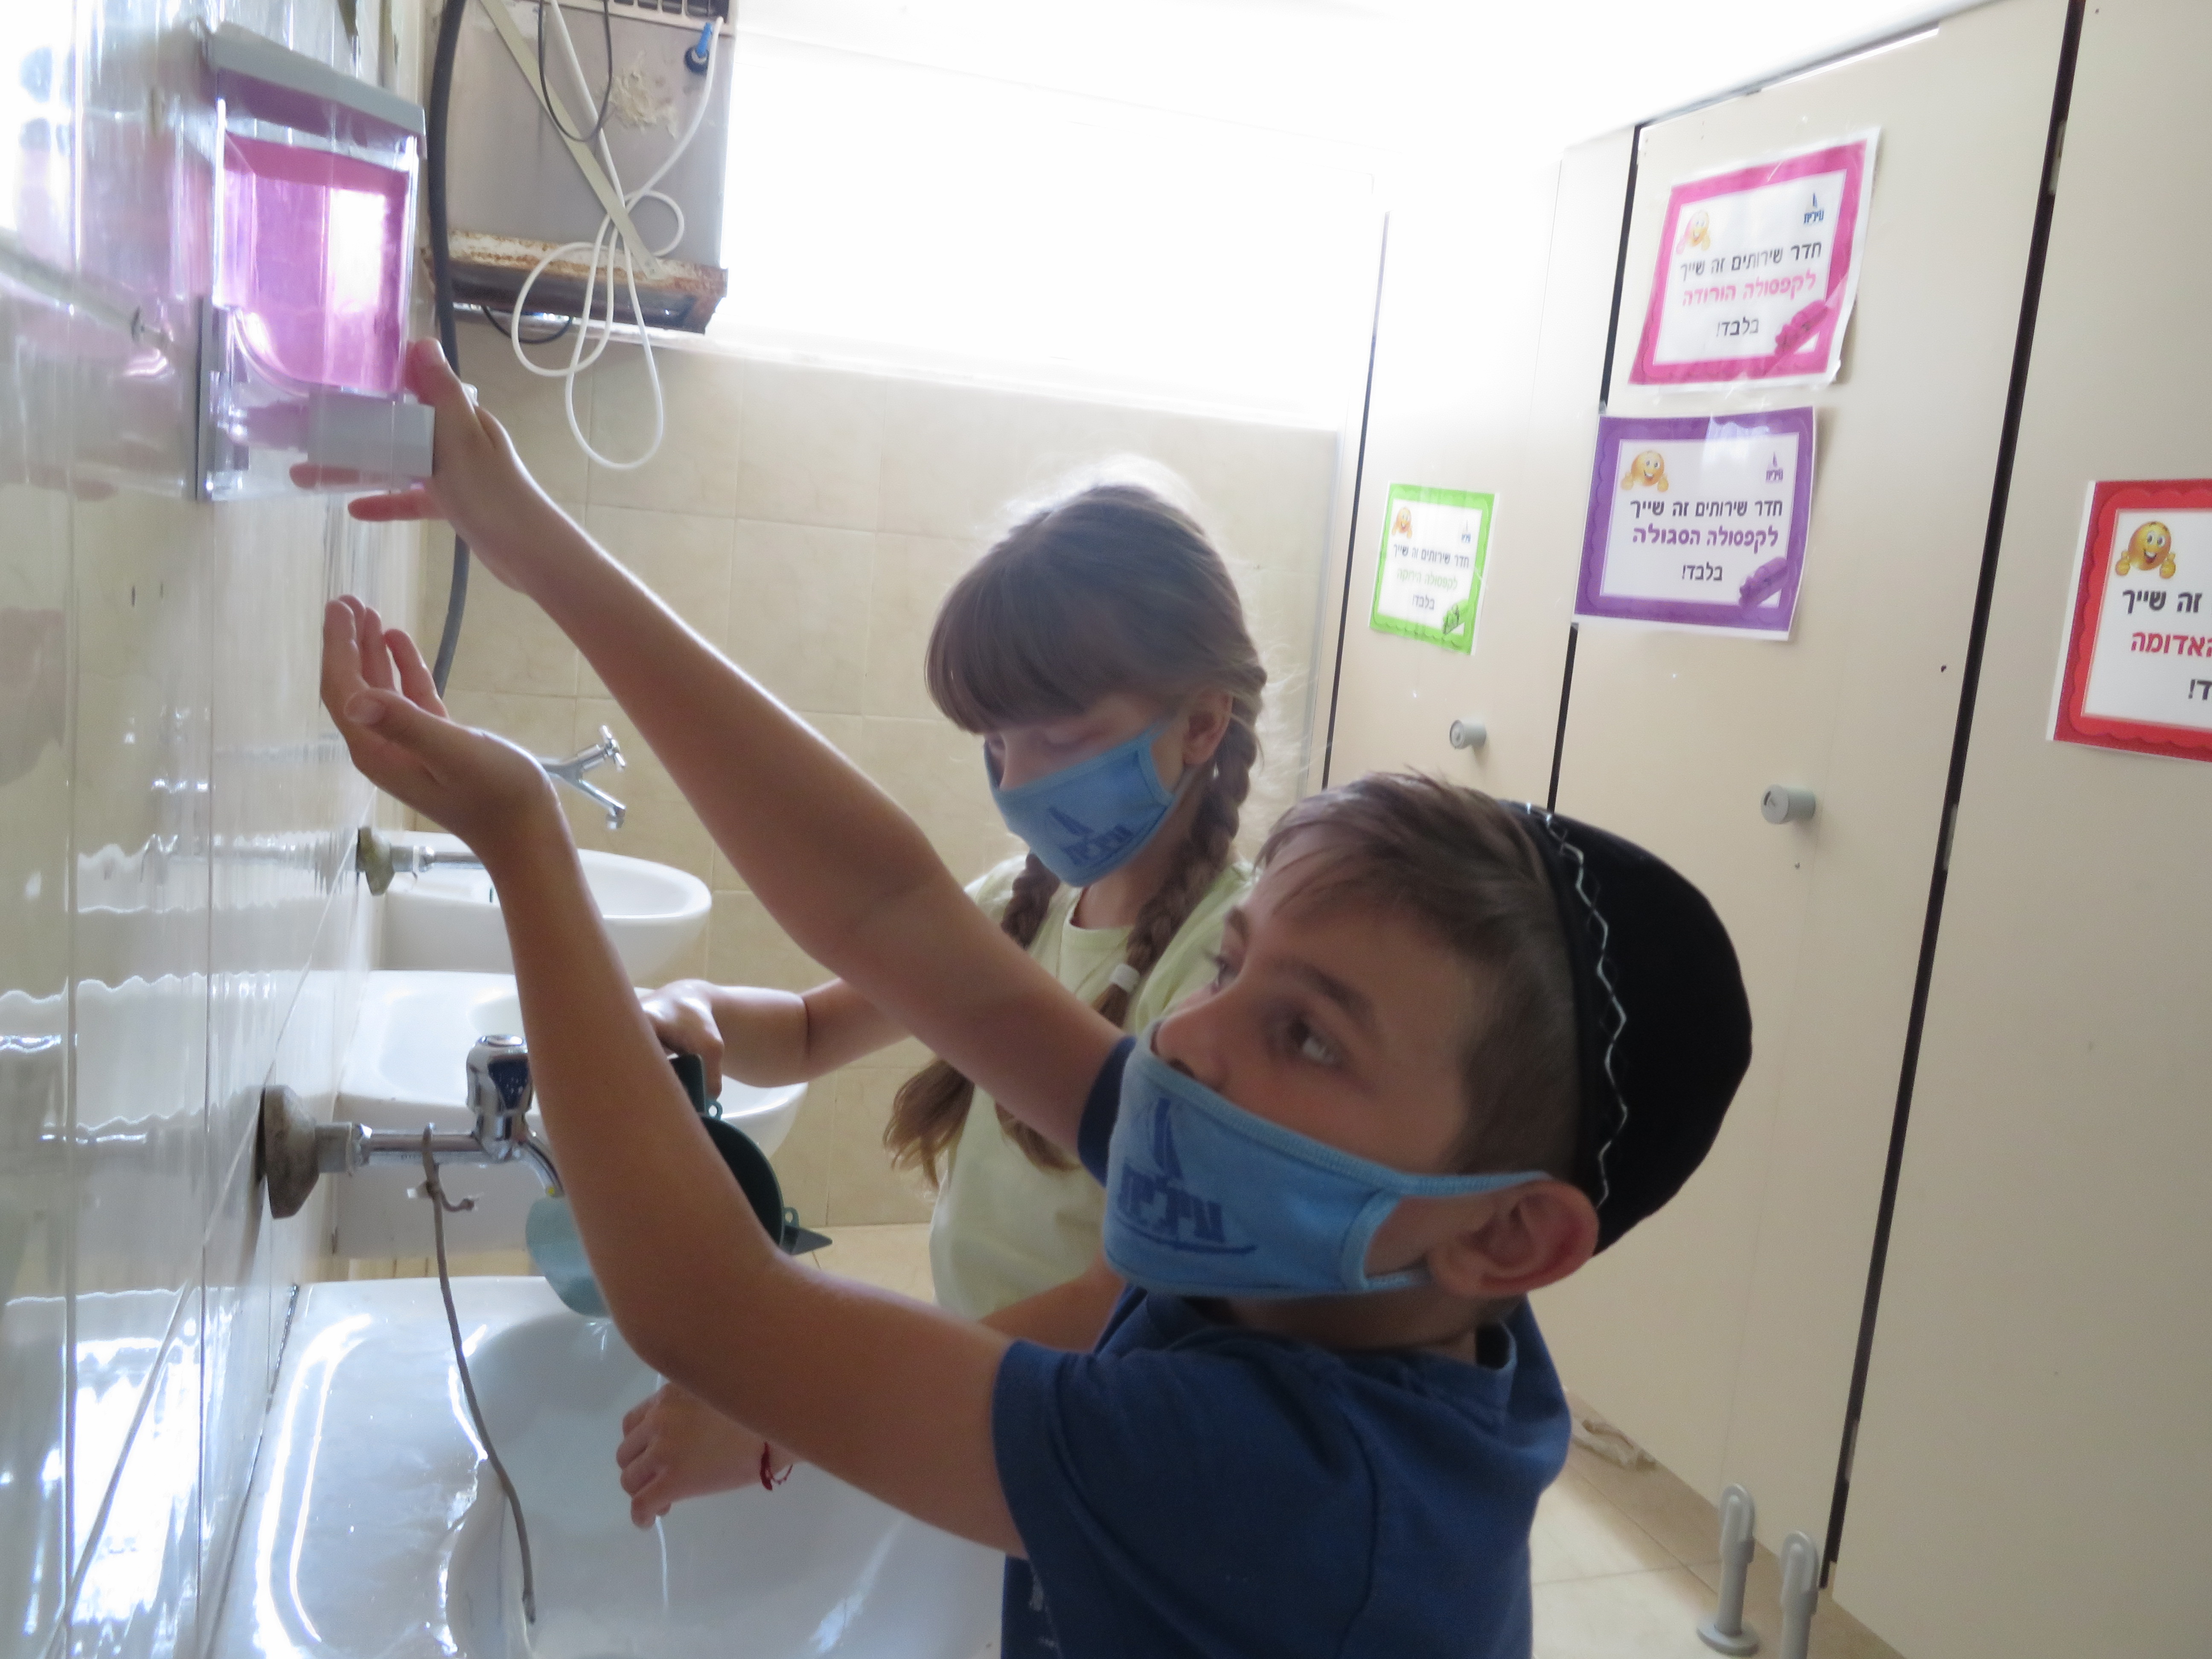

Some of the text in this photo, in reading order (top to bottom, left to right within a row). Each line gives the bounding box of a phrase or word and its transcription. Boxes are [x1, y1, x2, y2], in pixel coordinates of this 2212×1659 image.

[1681, 242, 1822, 281] חדר שירותים זה שייך
[1682, 269, 1816, 306] לקפסולה הורודה
[1717, 317, 1759, 337] בלבד!
[1630, 500, 1782, 518] חדר שירותים זה שייך
[1633, 523, 1778, 554] לקפסולה הסגולה
[1394, 544, 1408, 558] שייך
[1421, 549, 1450, 564] שירותים
[1455, 555, 1469, 568] חדר
[1682, 562, 1722, 580] בלבד!
[1413, 594, 1435, 610] בלבד!
[2122, 589, 2202, 614] זה שייך
